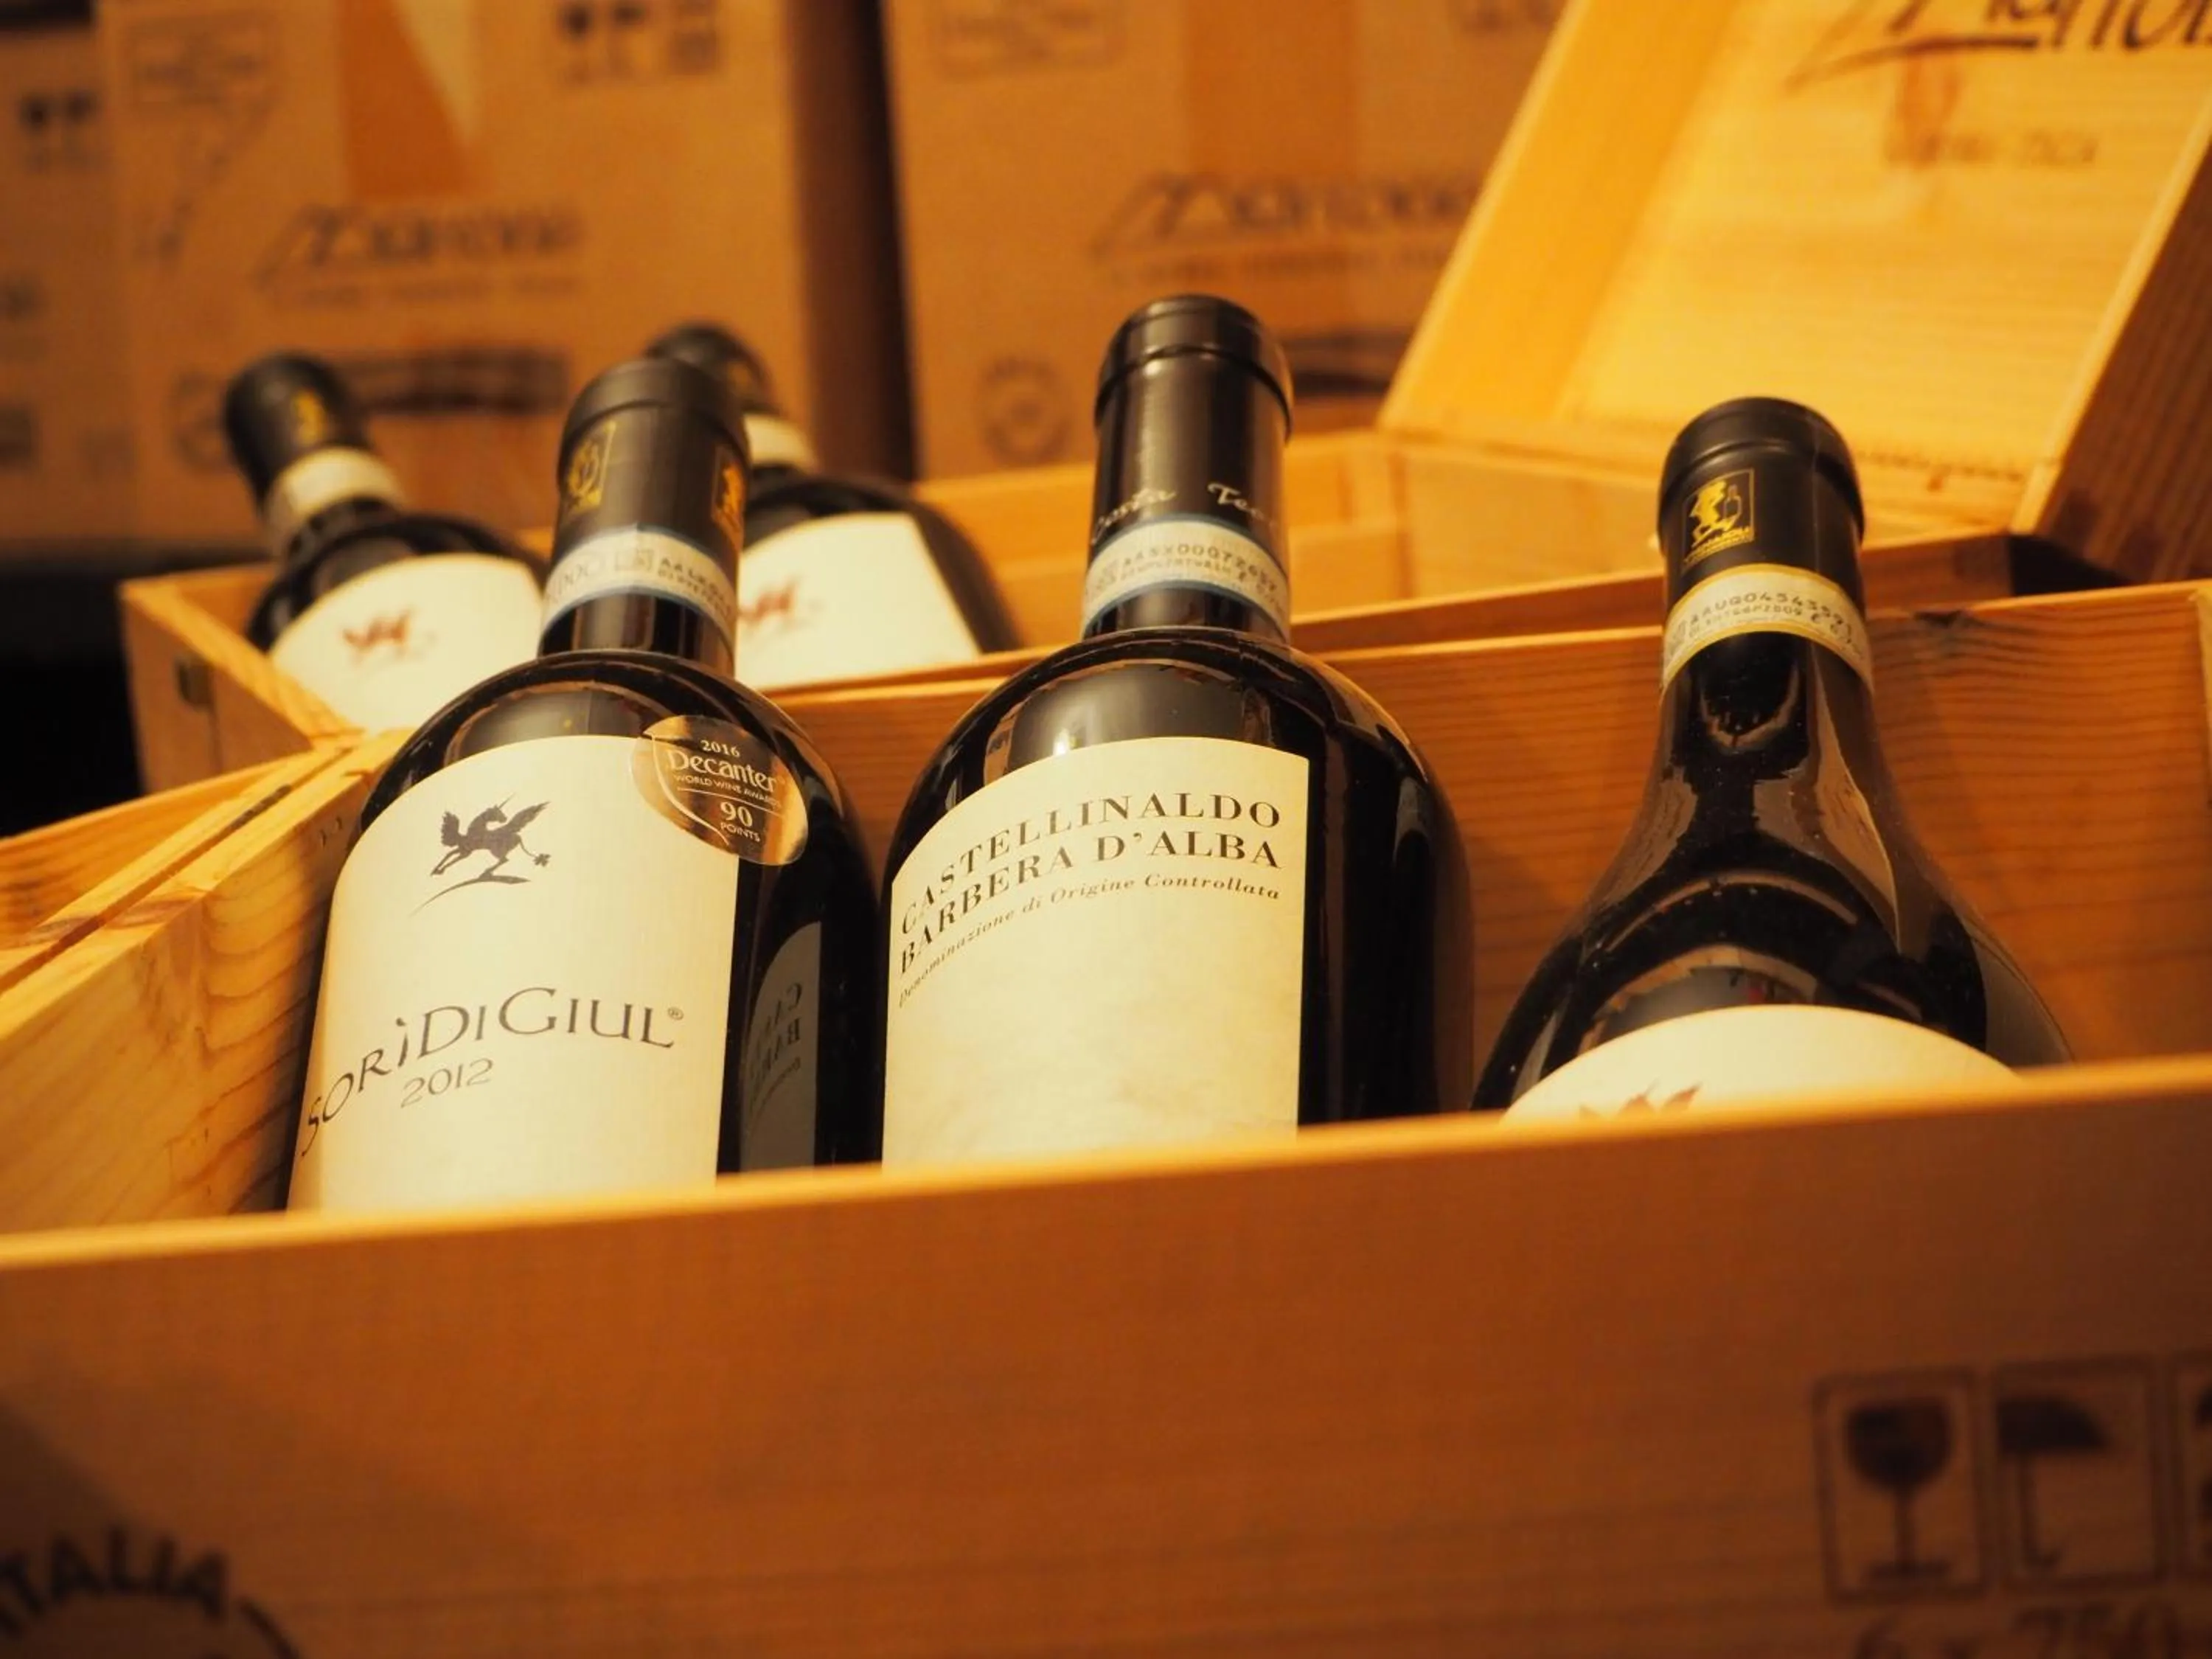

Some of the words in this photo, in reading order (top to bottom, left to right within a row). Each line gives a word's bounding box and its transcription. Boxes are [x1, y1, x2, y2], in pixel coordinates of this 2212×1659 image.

[667, 749, 777, 793] Decanter
[700, 740, 740, 758] 2016
[674, 774, 713, 787] WORLD
[714, 779, 742, 793] WINE
[720, 801, 753, 827] 90
[720, 822, 761, 843] POINTS
[902, 792, 1280, 935] CASTELLINALDO
[900, 845, 1073, 975] BARBERA
[1096, 831, 1282, 869] D'ALBA
[898, 908, 1015, 1008] Denominazione
[1022, 894, 1043, 913] di
[1050, 877, 1135, 902] Origine
[1144, 872, 1279, 900] Controllata
[400, 1058, 495, 1108] 2012
